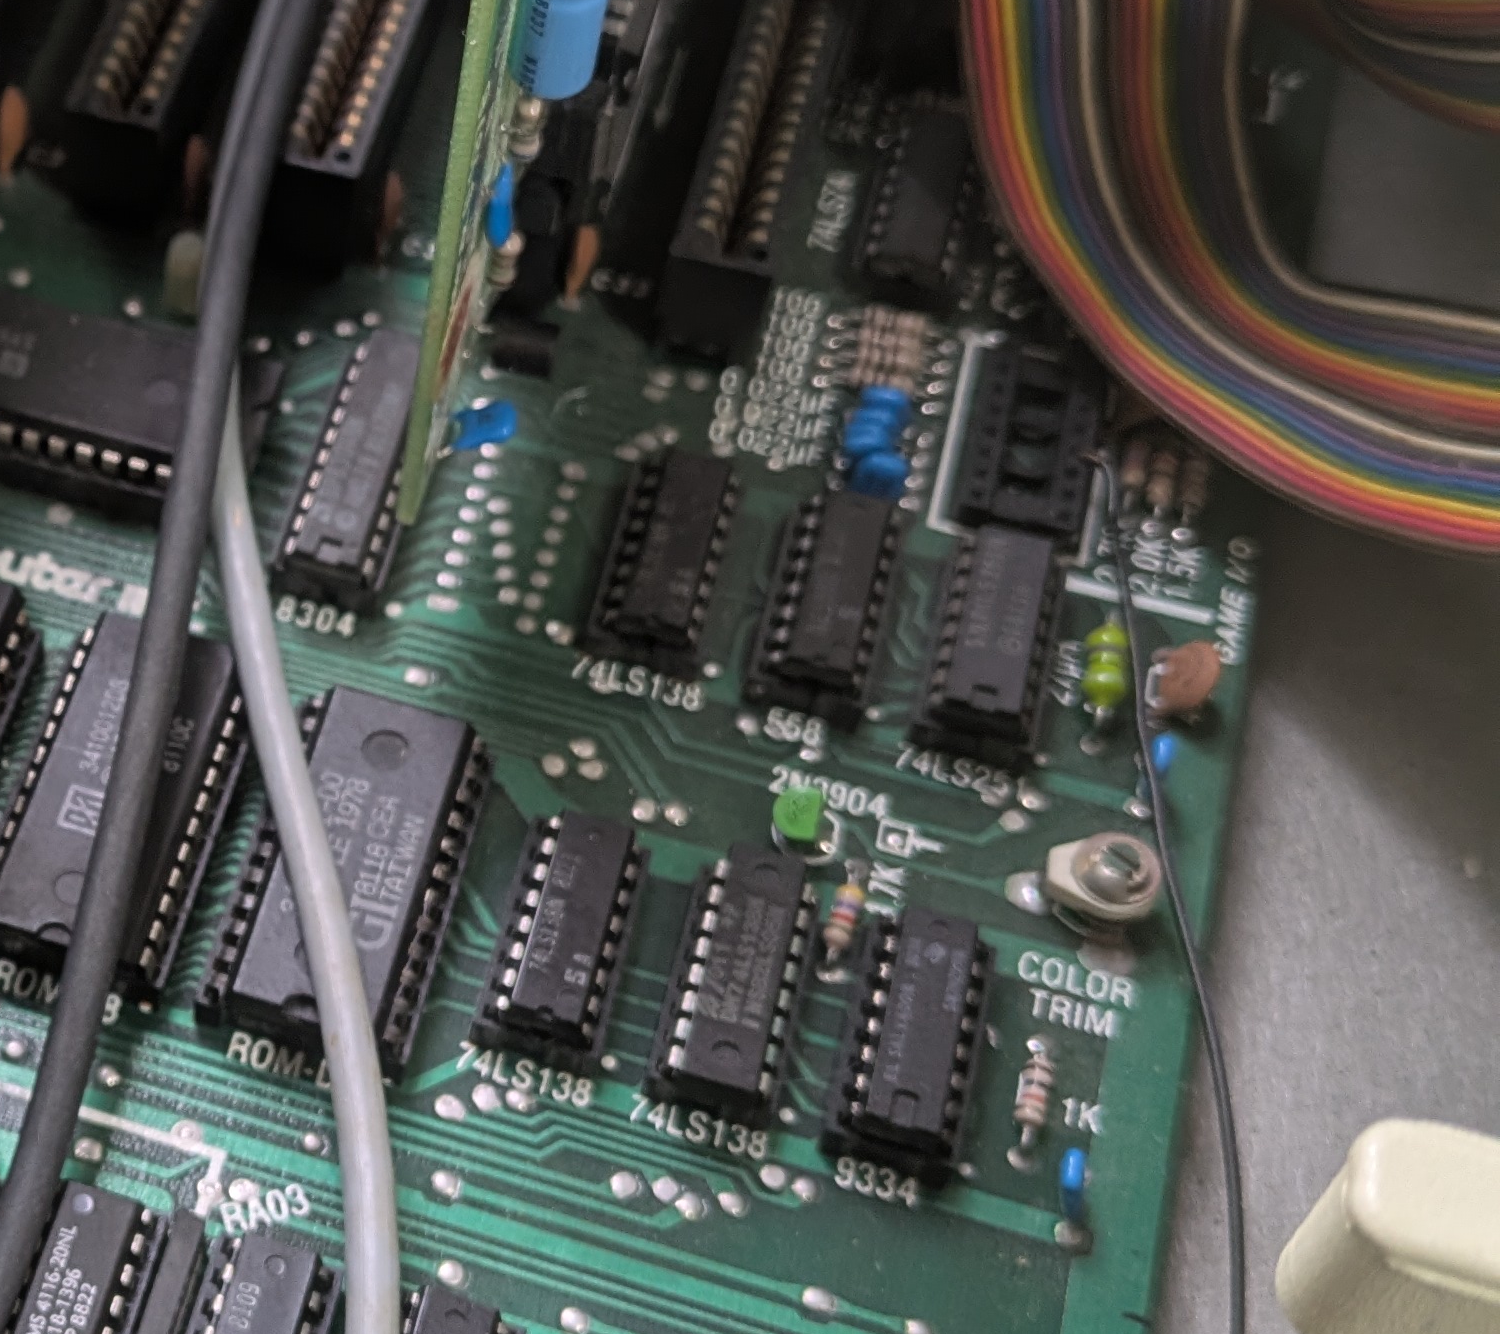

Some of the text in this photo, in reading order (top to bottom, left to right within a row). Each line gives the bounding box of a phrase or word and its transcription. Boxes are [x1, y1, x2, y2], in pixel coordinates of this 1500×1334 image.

[273, 593, 357, 640] 8304
[1205, 585, 1251, 666] GAME
[570, 652, 705, 713] 74LS138
[1013, 948, 1137, 1008] COLOR
[1023, 988, 1117, 1039] TRIM
[450, 1037, 596, 1112] 74LS138
[625, 1091, 772, 1163] 74LS138
[1058, 1096, 1103, 1134] 1K
[218, 1181, 311, 1236] RA03
[831, 1153, 922, 1208] 9334
[28, 1222, 82, 1312] 4116-20NL
[67, 1280, 100, 1328] 8822
